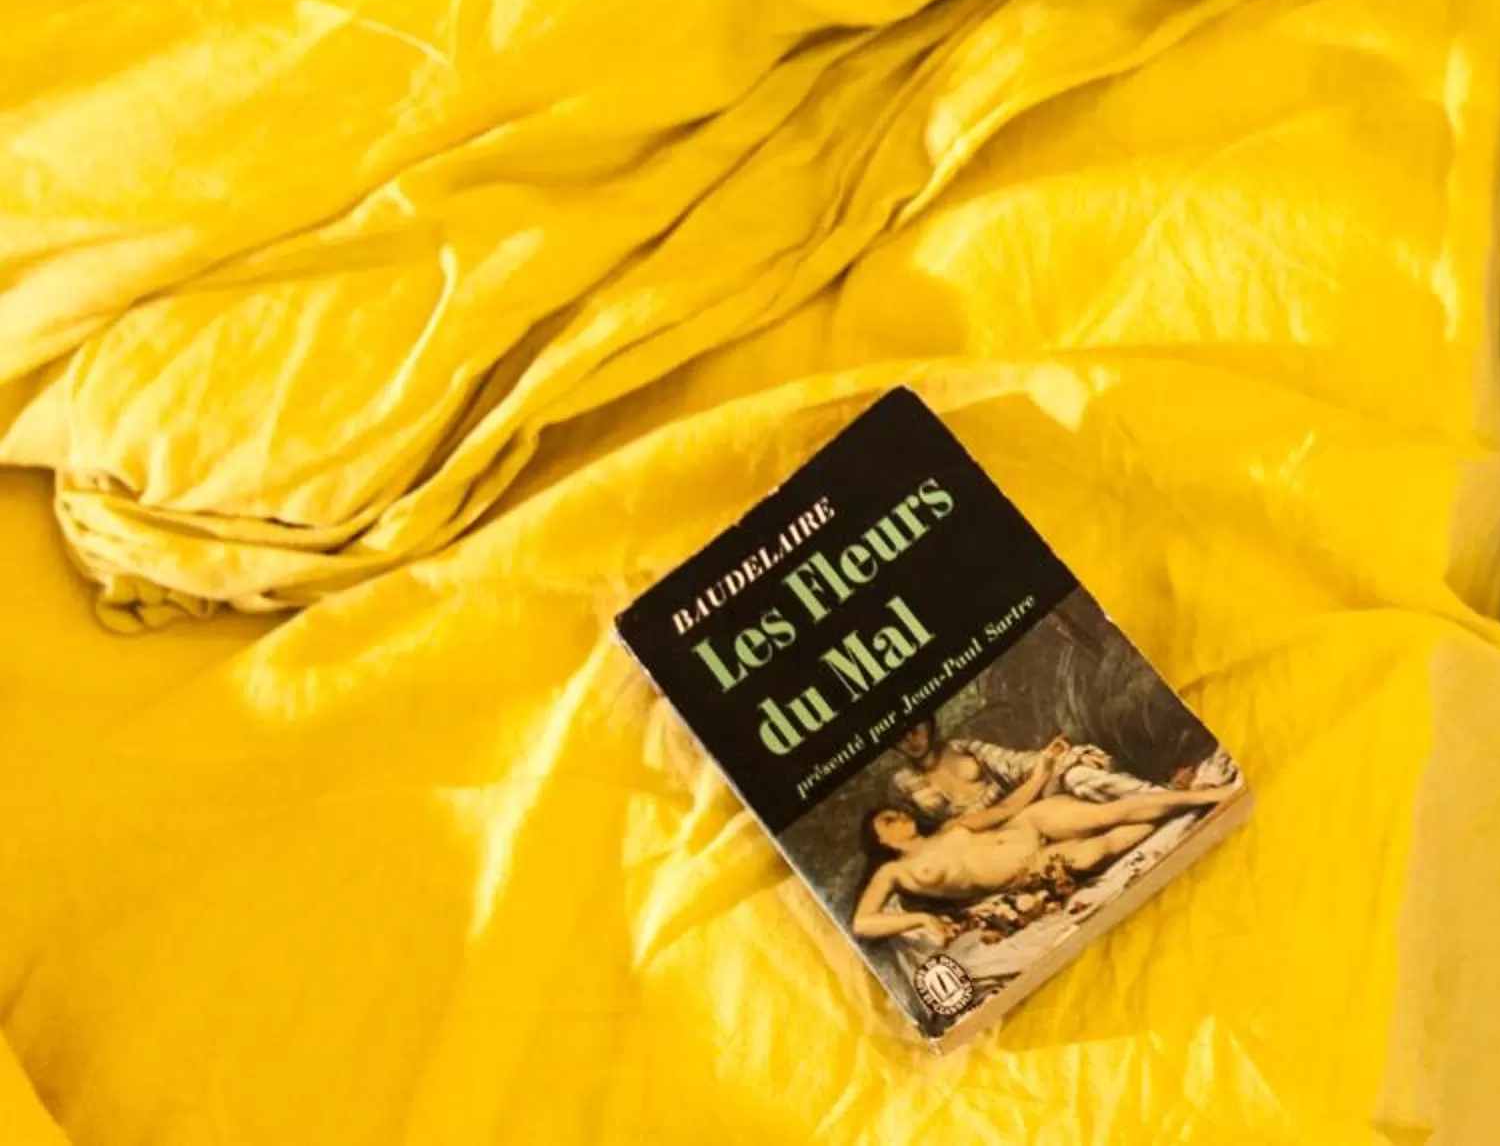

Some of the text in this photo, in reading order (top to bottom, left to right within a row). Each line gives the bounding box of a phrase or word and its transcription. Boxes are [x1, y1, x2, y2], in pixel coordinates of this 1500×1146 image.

[671, 497, 836, 636] BAUDELAIRE
[691, 477, 955, 694] Les Fleurs
[756, 595, 936, 756] du Mal
[796, 733, 866, 800] présenté
[868, 711, 898, 744] par
[983, 594, 1036, 643] Sartre
